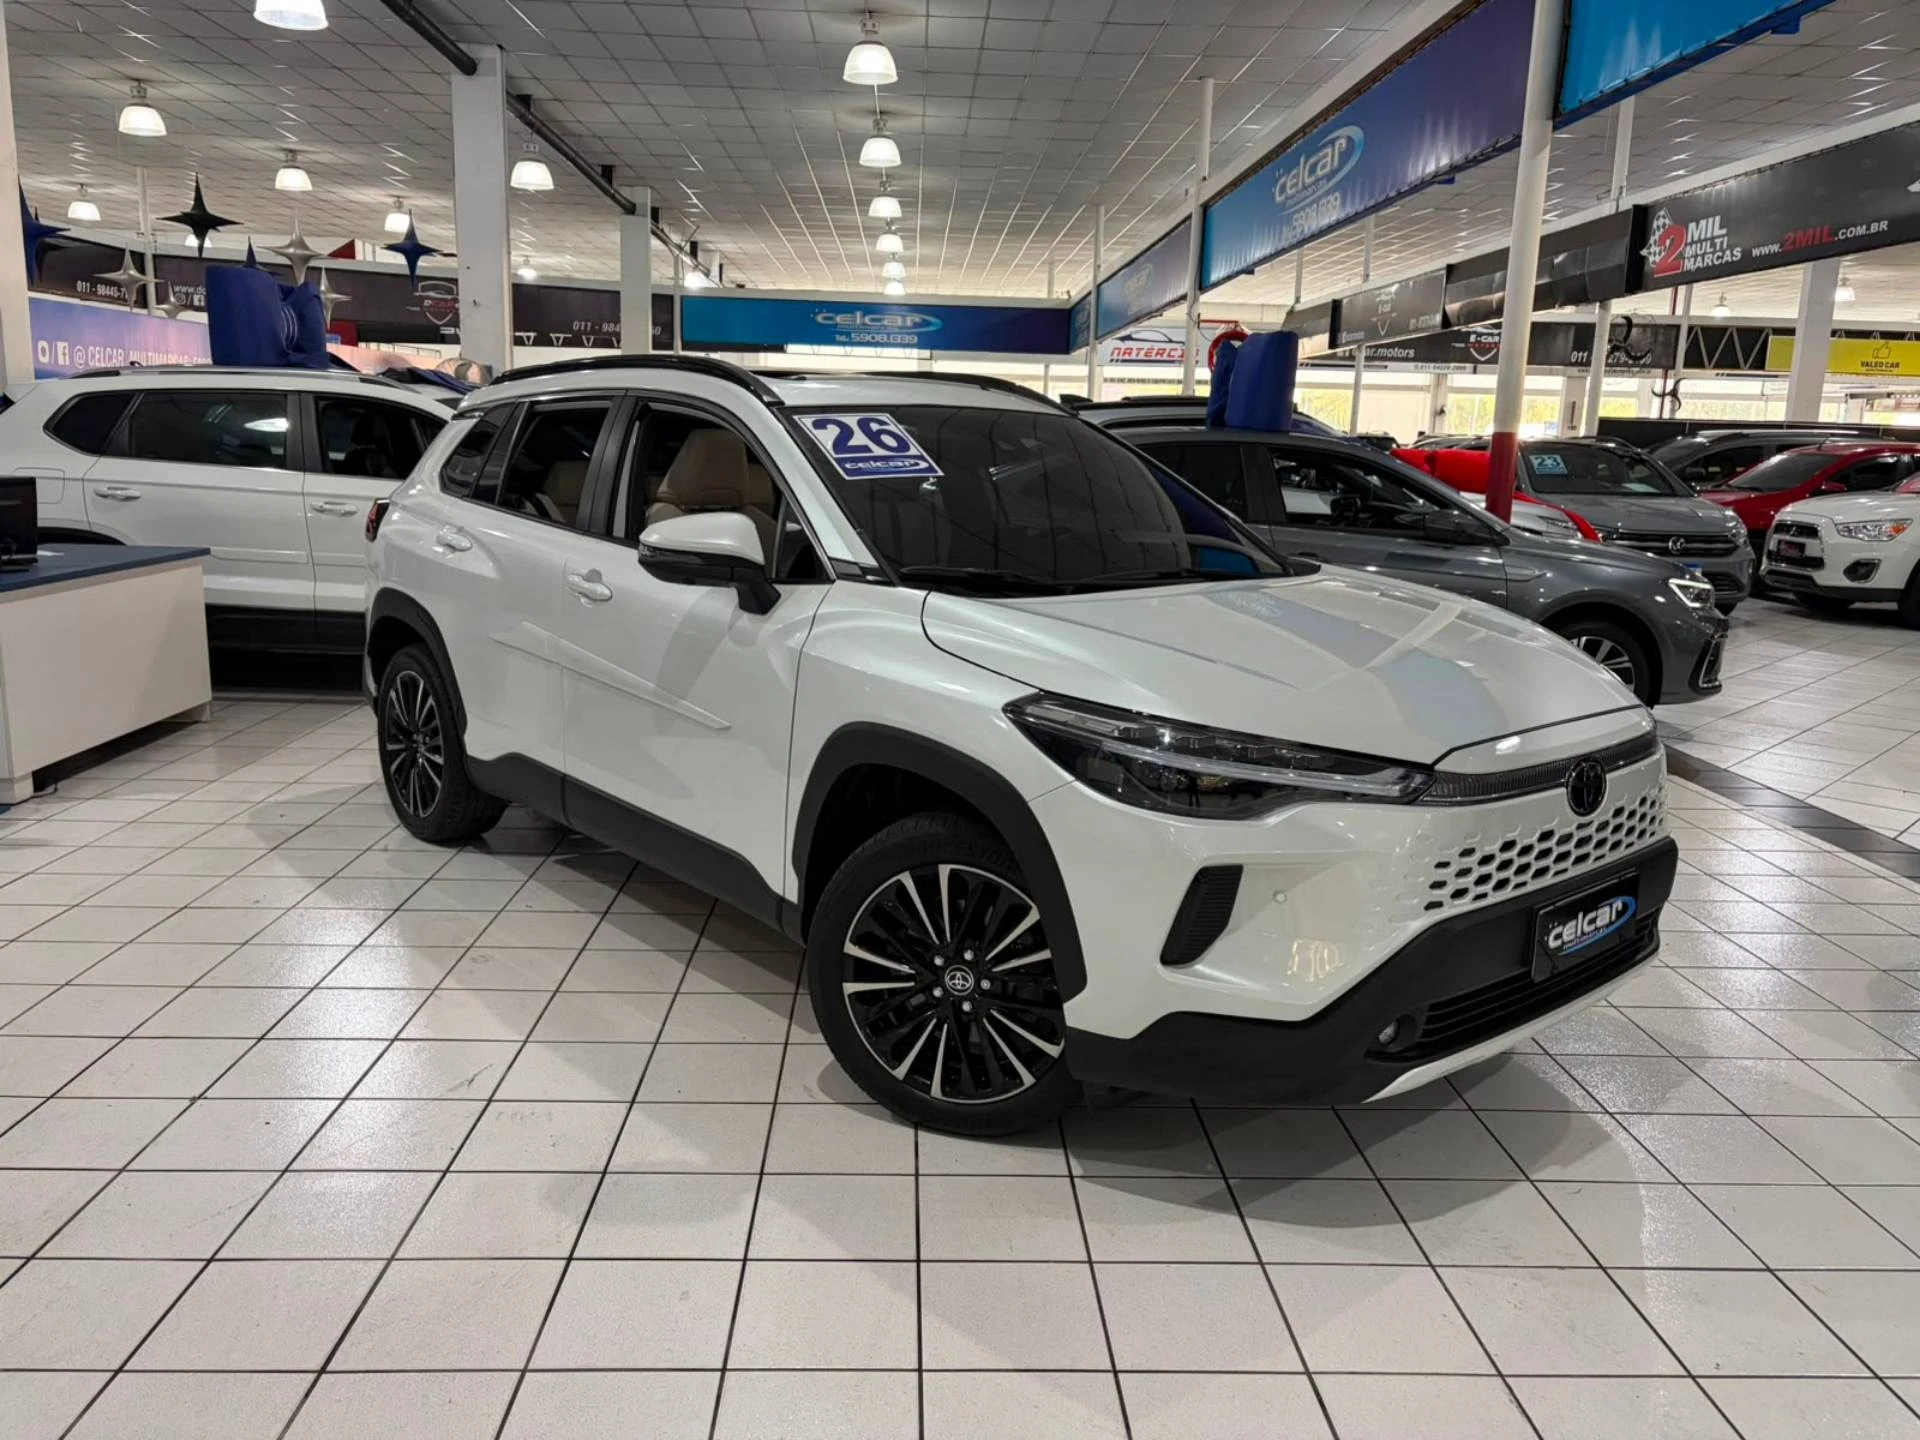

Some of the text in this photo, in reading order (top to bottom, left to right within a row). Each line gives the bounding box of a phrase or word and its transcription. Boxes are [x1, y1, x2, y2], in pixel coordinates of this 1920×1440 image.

[1275, 137, 1347, 203] celcar
[1655, 215, 1727, 277] 2 MIL
[1685, 236, 1728, 257] MULTI
[1684, 248, 1742, 272] MARCAS
[76, 280, 91, 293] 011
[573, 321, 592, 331] 011
[815, 310, 922, 326] celcar
[1570, 351, 1588, 363] 011
[812, 417, 911, 455] 26
[844, 460, 917, 470] celcar
[1534, 455, 1560, 467] 23
[1548, 899, 1623, 949] celcar
